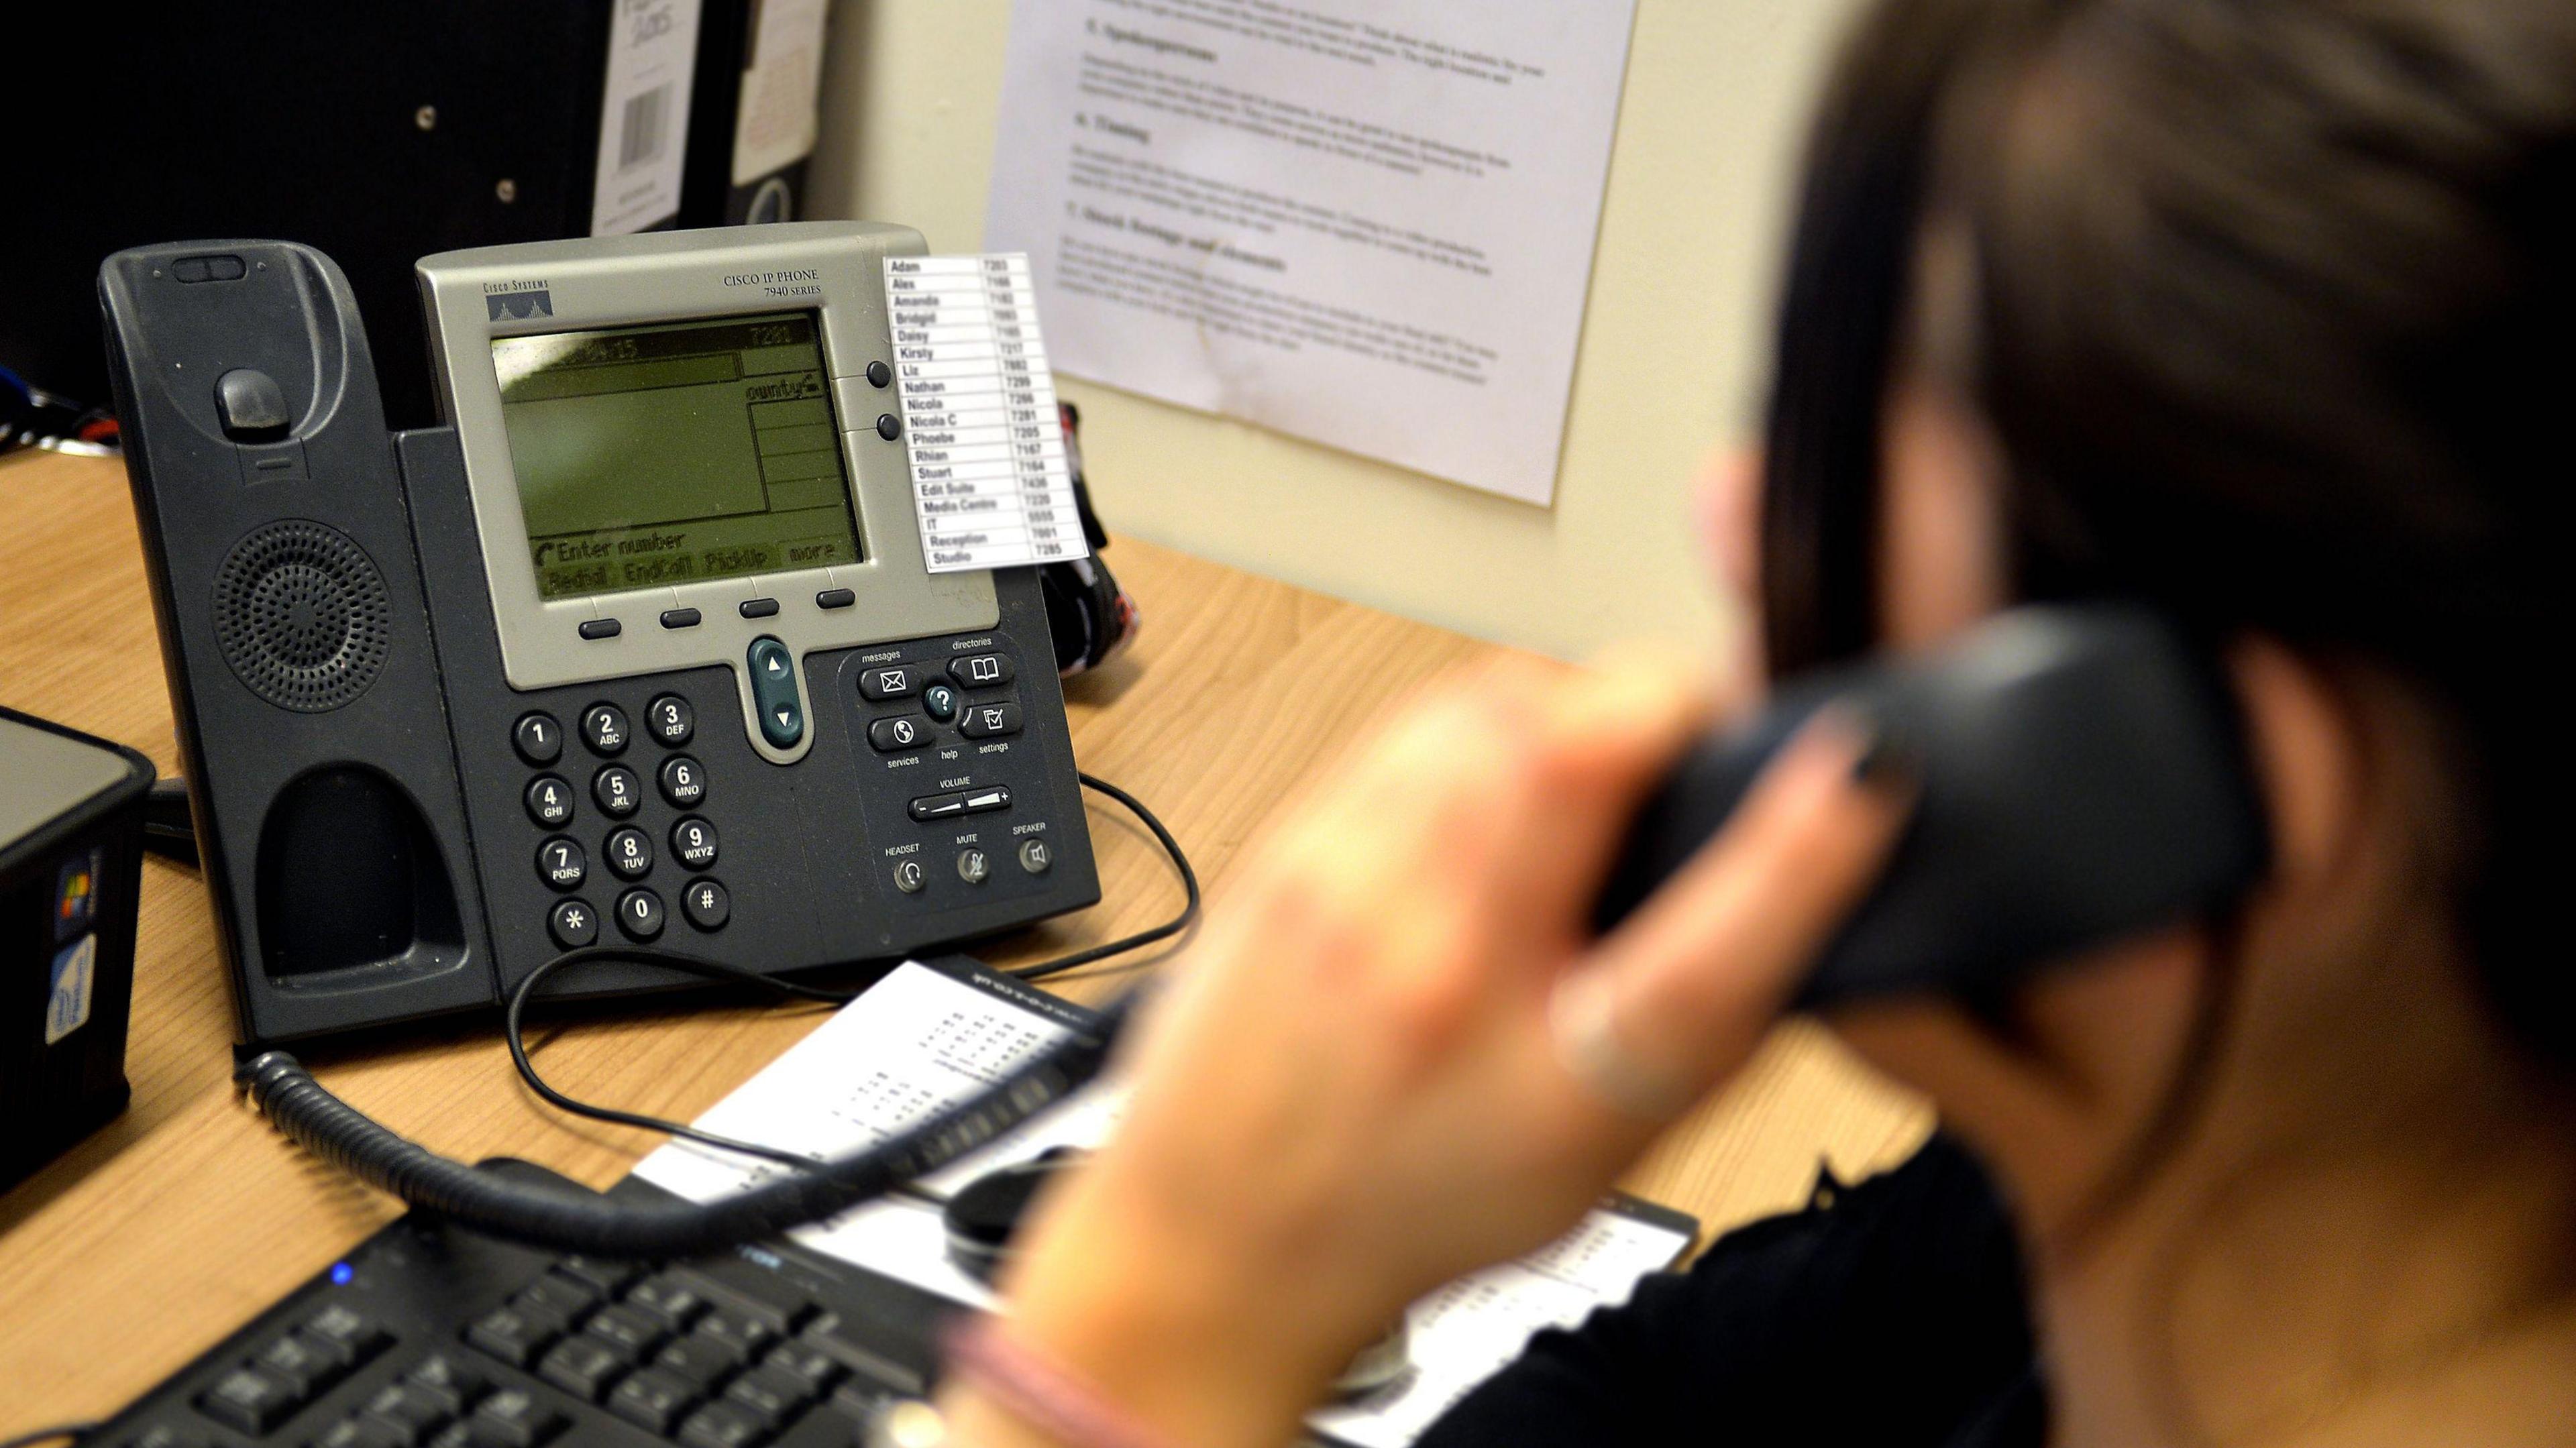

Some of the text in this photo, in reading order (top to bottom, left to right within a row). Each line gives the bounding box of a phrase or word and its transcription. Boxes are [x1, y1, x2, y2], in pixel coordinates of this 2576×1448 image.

[891, 260, 920, 272] Adam
[724, 269, 819, 286] CISCO IP PHONE
[892, 278, 915, 290] Alex
[483, 282, 508, 294] CISCO
[764, 285, 821, 297] 7940 SERIES
[894, 295, 940, 307] Amanda
[898, 330, 929, 343] Daisy
[900, 347, 933, 361] Kirsty
[903, 364, 919, 376] Liz
[906, 382, 945, 394] Nathan
[908, 398, 943, 410] Nicola
[910, 410, 1036, 428] Nicola C 7281
[913, 432, 955, 445] Phoebe
[915, 443, 1040, 462] Rhian 7167
[918, 467, 952, 480] Stuart
[921, 484, 943, 496] Edit
[947, 483, 975, 495] Suite
[924, 500, 958, 513] Media
[961, 498, 997, 511] Centre
[926, 518, 936, 530] IT
[556, 533, 686, 561] Enter number
[930, 534, 987, 548] Reception
[933, 543, 1062, 564] Studio 7285
[547, 566, 608, 590] Redial
[789, 542, 835, 563] more
[952, 637, 992, 651] directories
[862, 651, 901, 663] messages
[665, 705, 678, 724] 3
[599, 714, 613, 734] 2
[665, 724, 684, 736] DEF
[533, 723, 544, 742] 1
[599, 734, 620, 746] ABC
[941, 749, 958, 761] help
[979, 742, 1009, 755] settings
[888, 756, 919, 769] services
[676, 765, 690, 785] 6
[610, 776, 625, 795] 5
[940, 776, 971, 789] VOLUME
[544, 785, 557, 805] 4
[675, 785, 699, 797] MNO
[611, 796, 629, 807] JKL
[544, 806, 563, 818] GHI
[1012, 822, 1046, 836] SPEAKER
[688, 827, 702, 846] 9
[956, 834, 977, 845] MUTE
[623, 838, 637, 856] 8
[684, 846, 714, 860] WXYZ
[885, 843, 920, 857] HEADSET
[555, 848, 568, 867] 7
[623, 857, 645, 869] TUV
[552, 867, 580, 880] PQRS
[635, 898, 648, 918] 0
